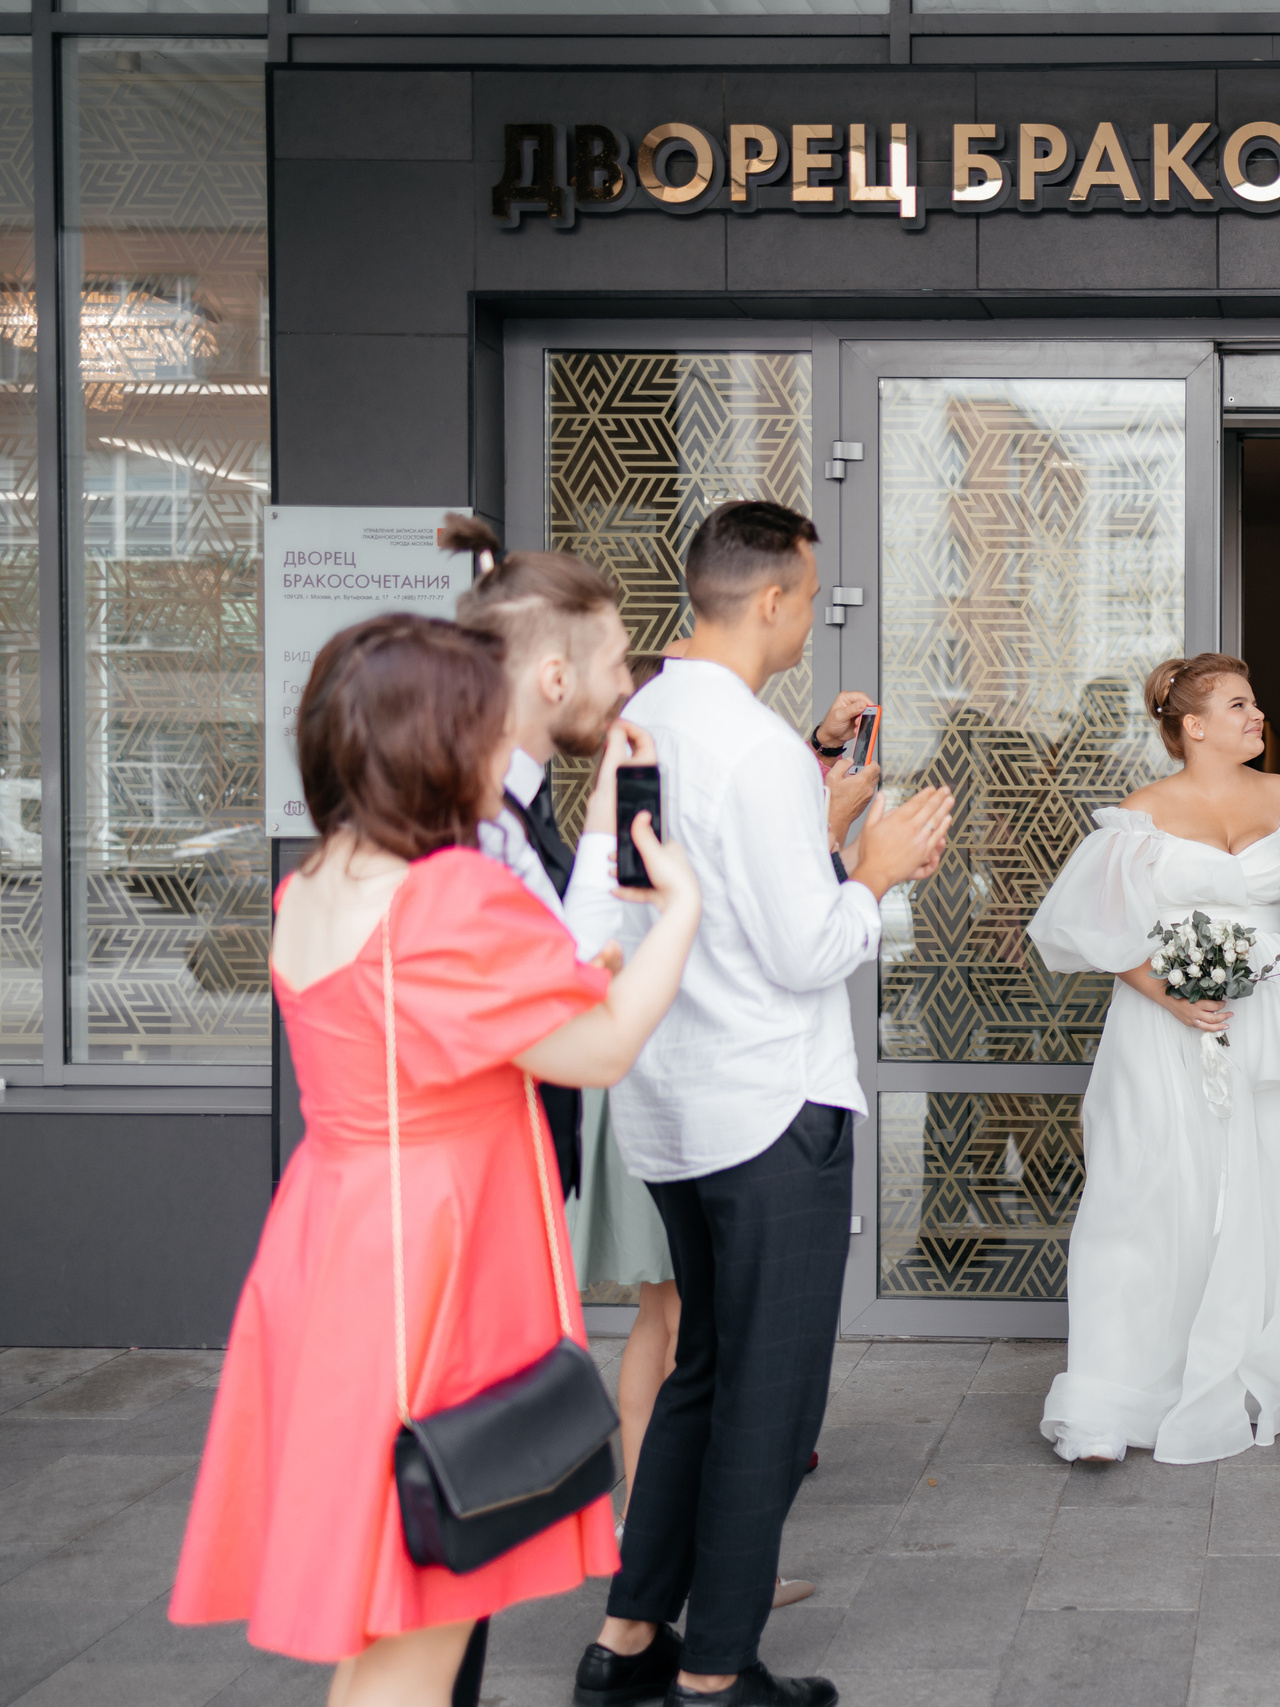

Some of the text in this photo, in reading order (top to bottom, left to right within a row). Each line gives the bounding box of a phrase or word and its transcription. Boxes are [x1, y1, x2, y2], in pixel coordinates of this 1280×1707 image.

[491, 122, 917, 219] ДВОРЕЦ
[283, 551, 357, 569] ДВОРЕЦ
[283, 573, 450, 589] БРАКОСОЧЕТАНИЯ
[284, 651, 312, 663] ВИД
